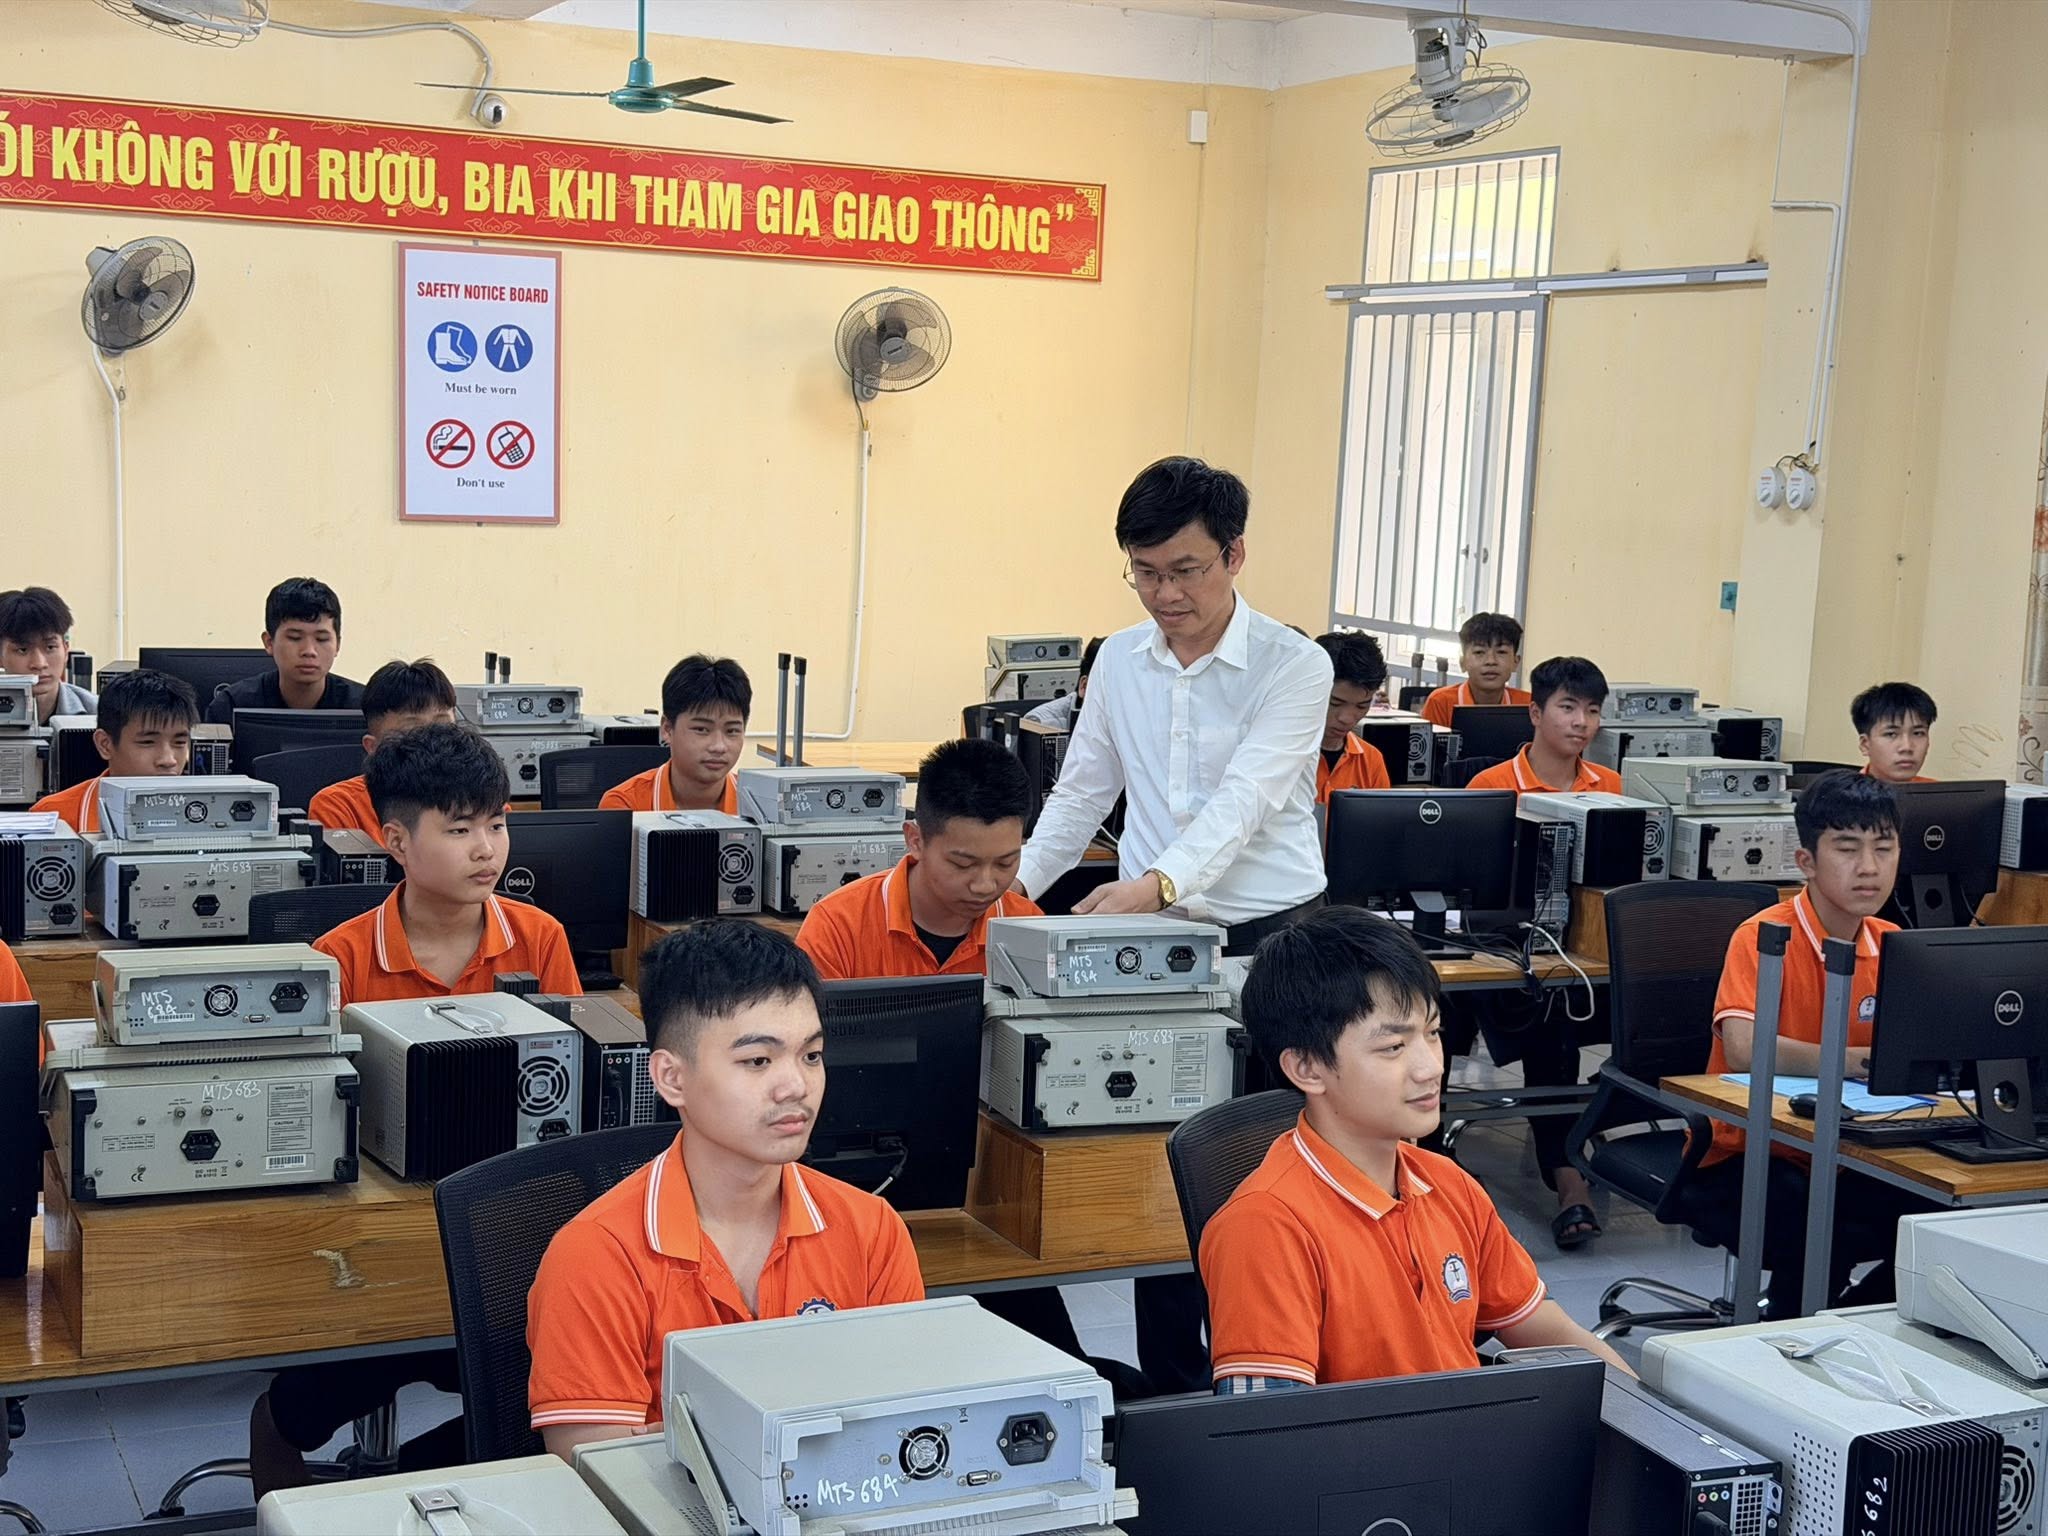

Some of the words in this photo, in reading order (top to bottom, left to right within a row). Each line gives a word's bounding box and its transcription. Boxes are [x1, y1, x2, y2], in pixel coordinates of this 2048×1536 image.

[52, 121, 213, 191] KHÔNG
[229, 127, 302, 197] VỚI
[318, 147, 449, 217] RƯỢU,
[464, 162, 535, 216] BIA
[549, 167, 617, 222] KHI
[630, 175, 743, 231] THAM
[756, 185, 820, 237] GIA
[833, 191, 920, 245] GIAO
[417, 281, 460, 299] SAFETY
[464, 284, 506, 301] NOTICE
[509, 287, 549, 304] BOARD
[444, 382, 472, 394] Must
[475, 383, 488, 395] be
[490, 385, 517, 396] worn
[488, 480, 505, 490] use
[144, 795, 167, 808] MTS
[791, 792, 808, 802] MTS
[1422, 808, 1440, 816] DELL
[1926, 834, 1943, 842] DELL
[869, 843, 887, 854] 683
[208, 862, 230, 875] MTS
[232, 862, 252, 874] 683
[508, 878, 532, 887] DELL
[1069, 954, 1093, 969] MTS
[141, 989, 173, 1007] MTS
[1998, 1003, 2020, 1013] DELL
[1153, 1029, 1174, 1045] 683
[202, 1083, 234, 1102] MTS
[235, 1081, 262, 1098] 683
[817, 1477, 856, 1506] MTS
[1863, 1476, 1888, 1521] 682
